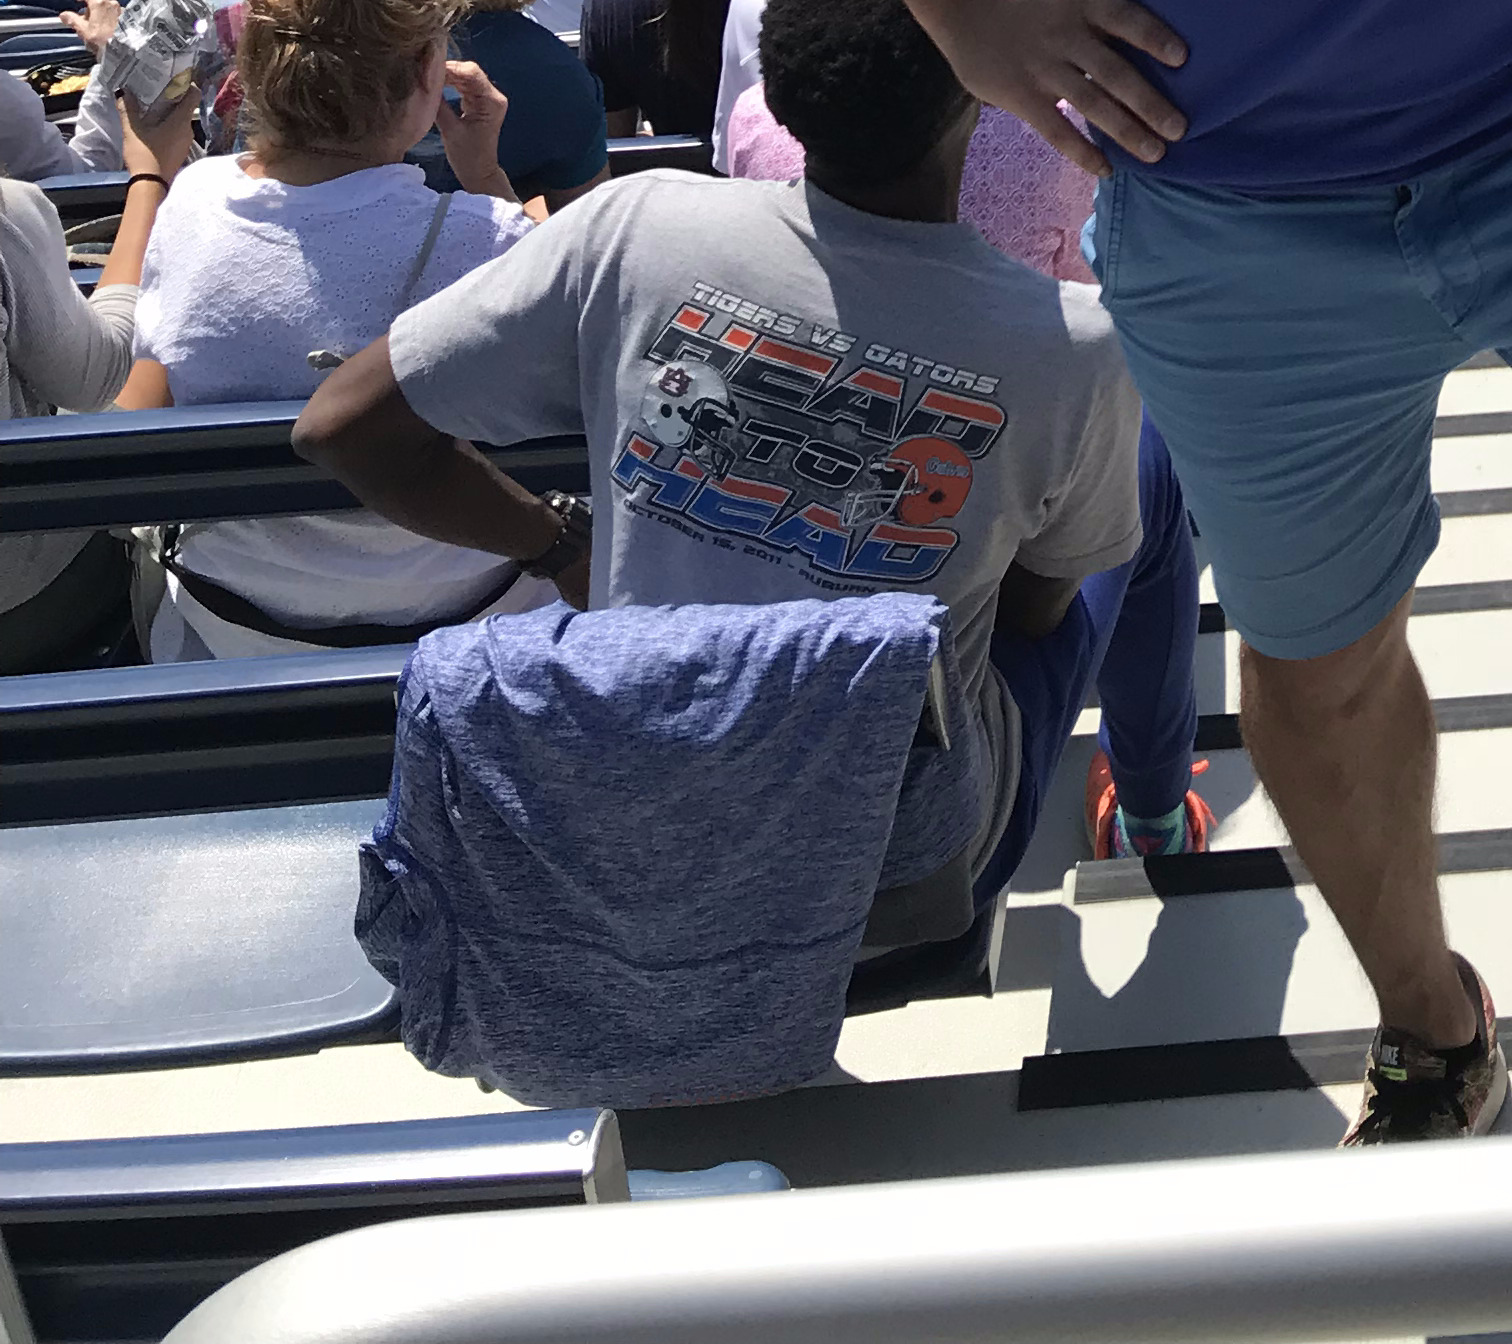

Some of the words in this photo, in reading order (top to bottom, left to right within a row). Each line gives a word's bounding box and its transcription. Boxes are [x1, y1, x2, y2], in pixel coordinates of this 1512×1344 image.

[644, 302, 1008, 460] HEAD
[692, 279, 804, 341] TIGERS
[810, 323, 857, 355] VS
[864, 342, 1002, 395] GATORS
[610, 430, 960, 584] HEAD
[740, 416, 864, 489] TO
[624, 499, 704, 543] OCTOBER
[712, 536, 738, 552] 15,
[743, 544, 782, 566] 2011
[800, 569, 876, 594] AUBURN
